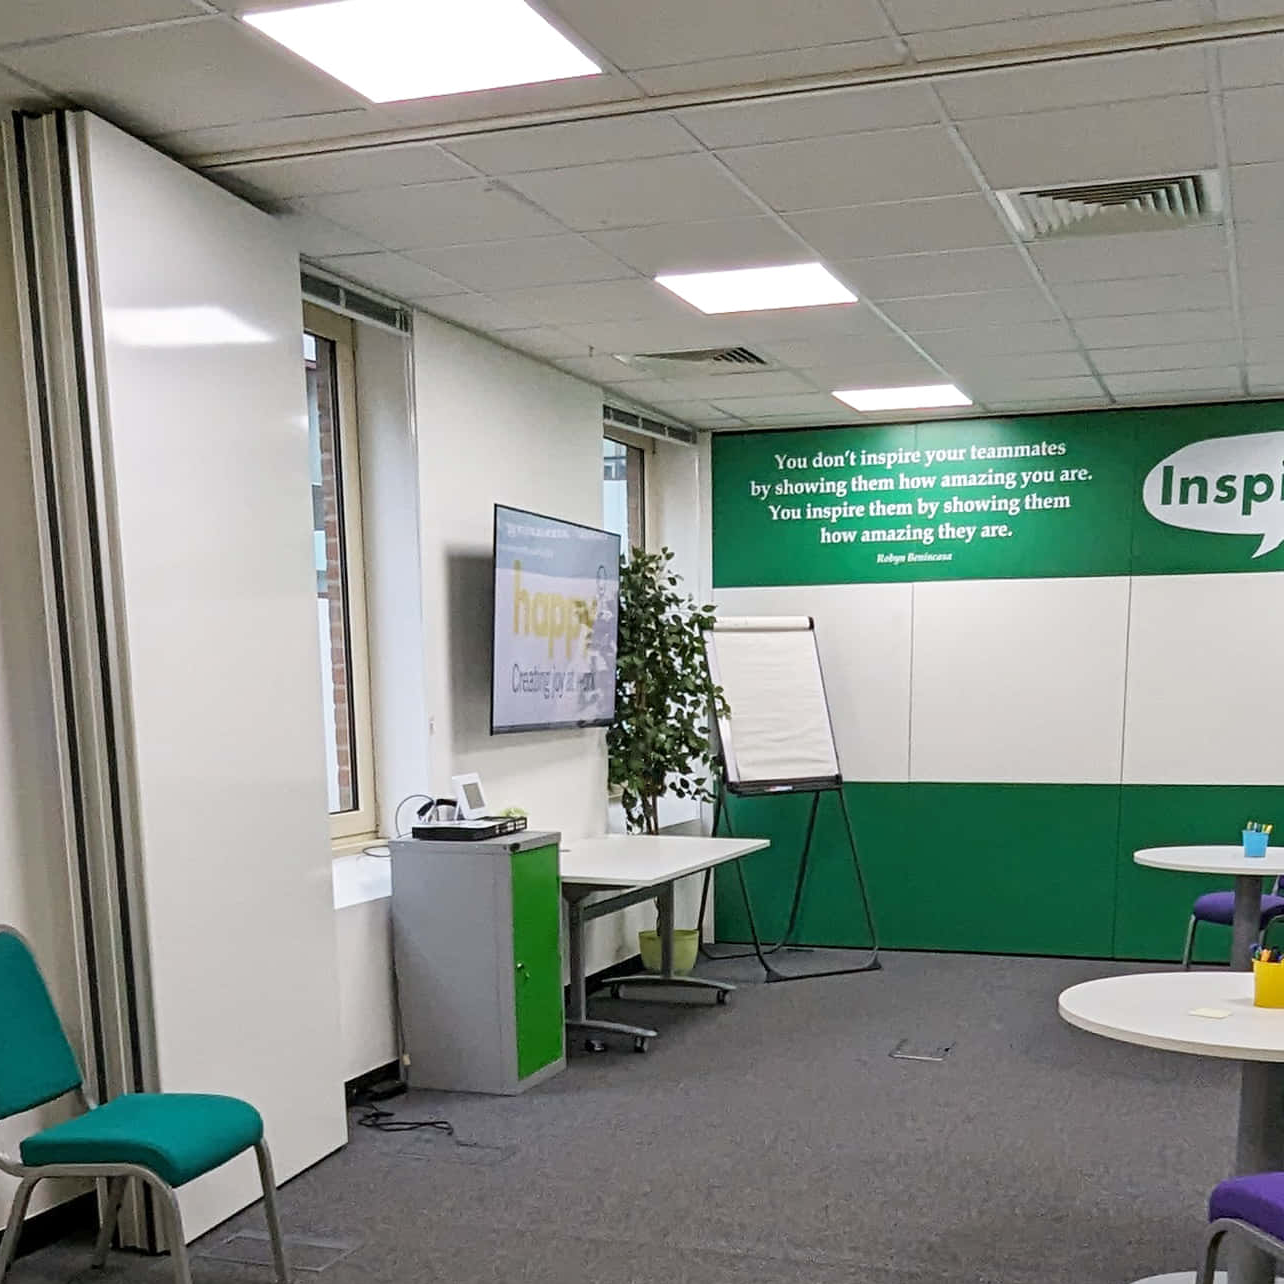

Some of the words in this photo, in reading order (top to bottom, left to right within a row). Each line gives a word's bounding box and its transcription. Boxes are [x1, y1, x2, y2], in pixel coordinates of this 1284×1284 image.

[774, 453, 808, 470] You
[812, 450, 856, 468] don't
[860, 448, 921, 469] inspire
[924, 449, 967, 467] your
[970, 441, 1067, 460] teammates
[750, 480, 771, 500] by
[774, 477, 847, 497] showing
[851, 475, 895, 492] them
[899, 473, 937, 490] how
[940, 468, 1017, 489] amazing
[1020, 470, 1055, 488] you
[1059, 468, 1093, 482] are.
[768, 505, 802, 521] You
[806, 502, 865, 523] inspire
[868, 500, 913, 517] them
[917, 498, 940, 519] by
[943, 495, 1020, 516] showing
[1024, 493, 1071, 510] them
[820, 527, 857, 544] how
[860, 524, 935, 545] amazing
[938, 522, 976, 543] they
[980, 524, 1013, 538] are.
[876, 553, 906, 565] Robyn
[512, 560, 598, 662] happy
